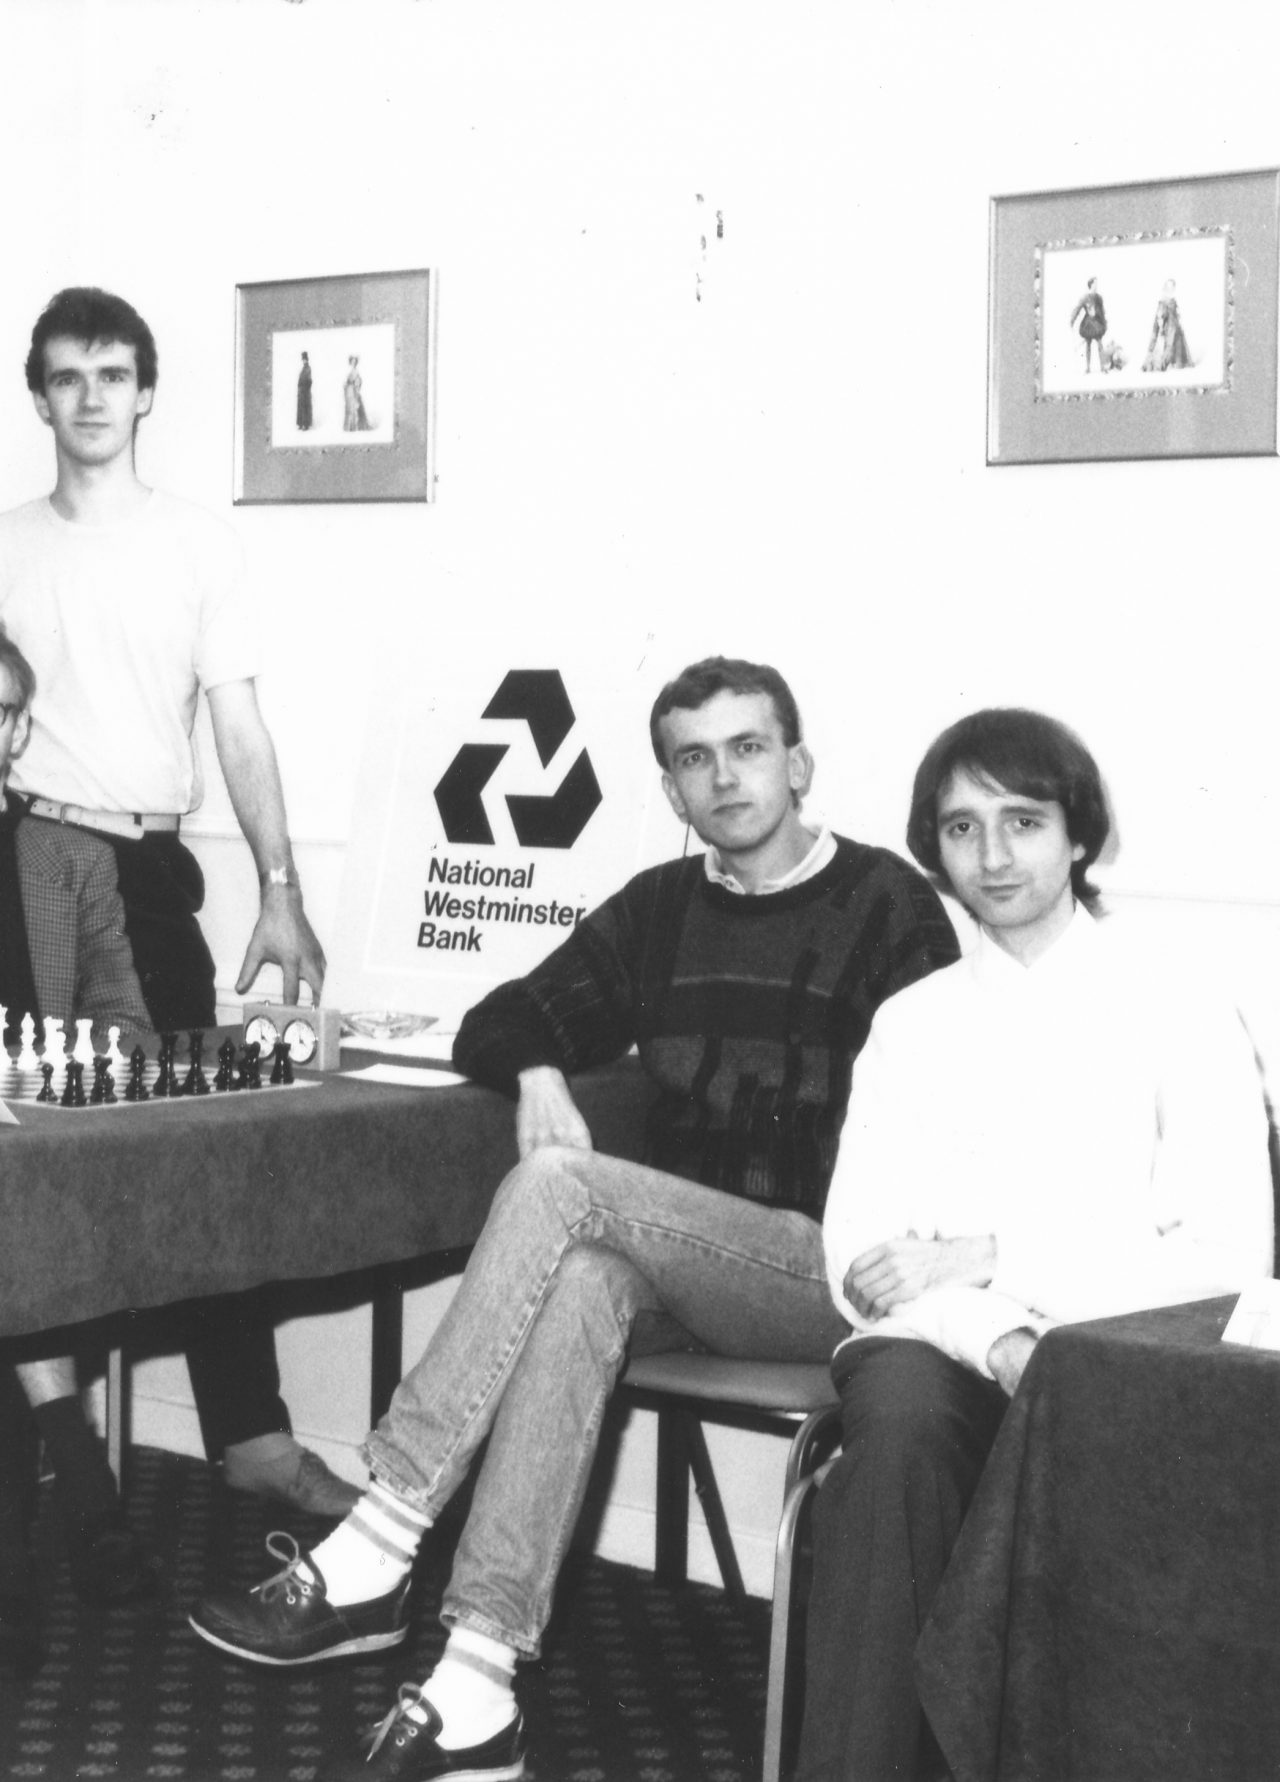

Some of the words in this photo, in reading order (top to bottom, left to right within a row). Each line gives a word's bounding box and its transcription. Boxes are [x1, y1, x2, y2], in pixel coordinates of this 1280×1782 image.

[428, 857, 535, 889] National
[424, 890, 586, 927] Westminster
[417, 922, 482, 952] Bank
